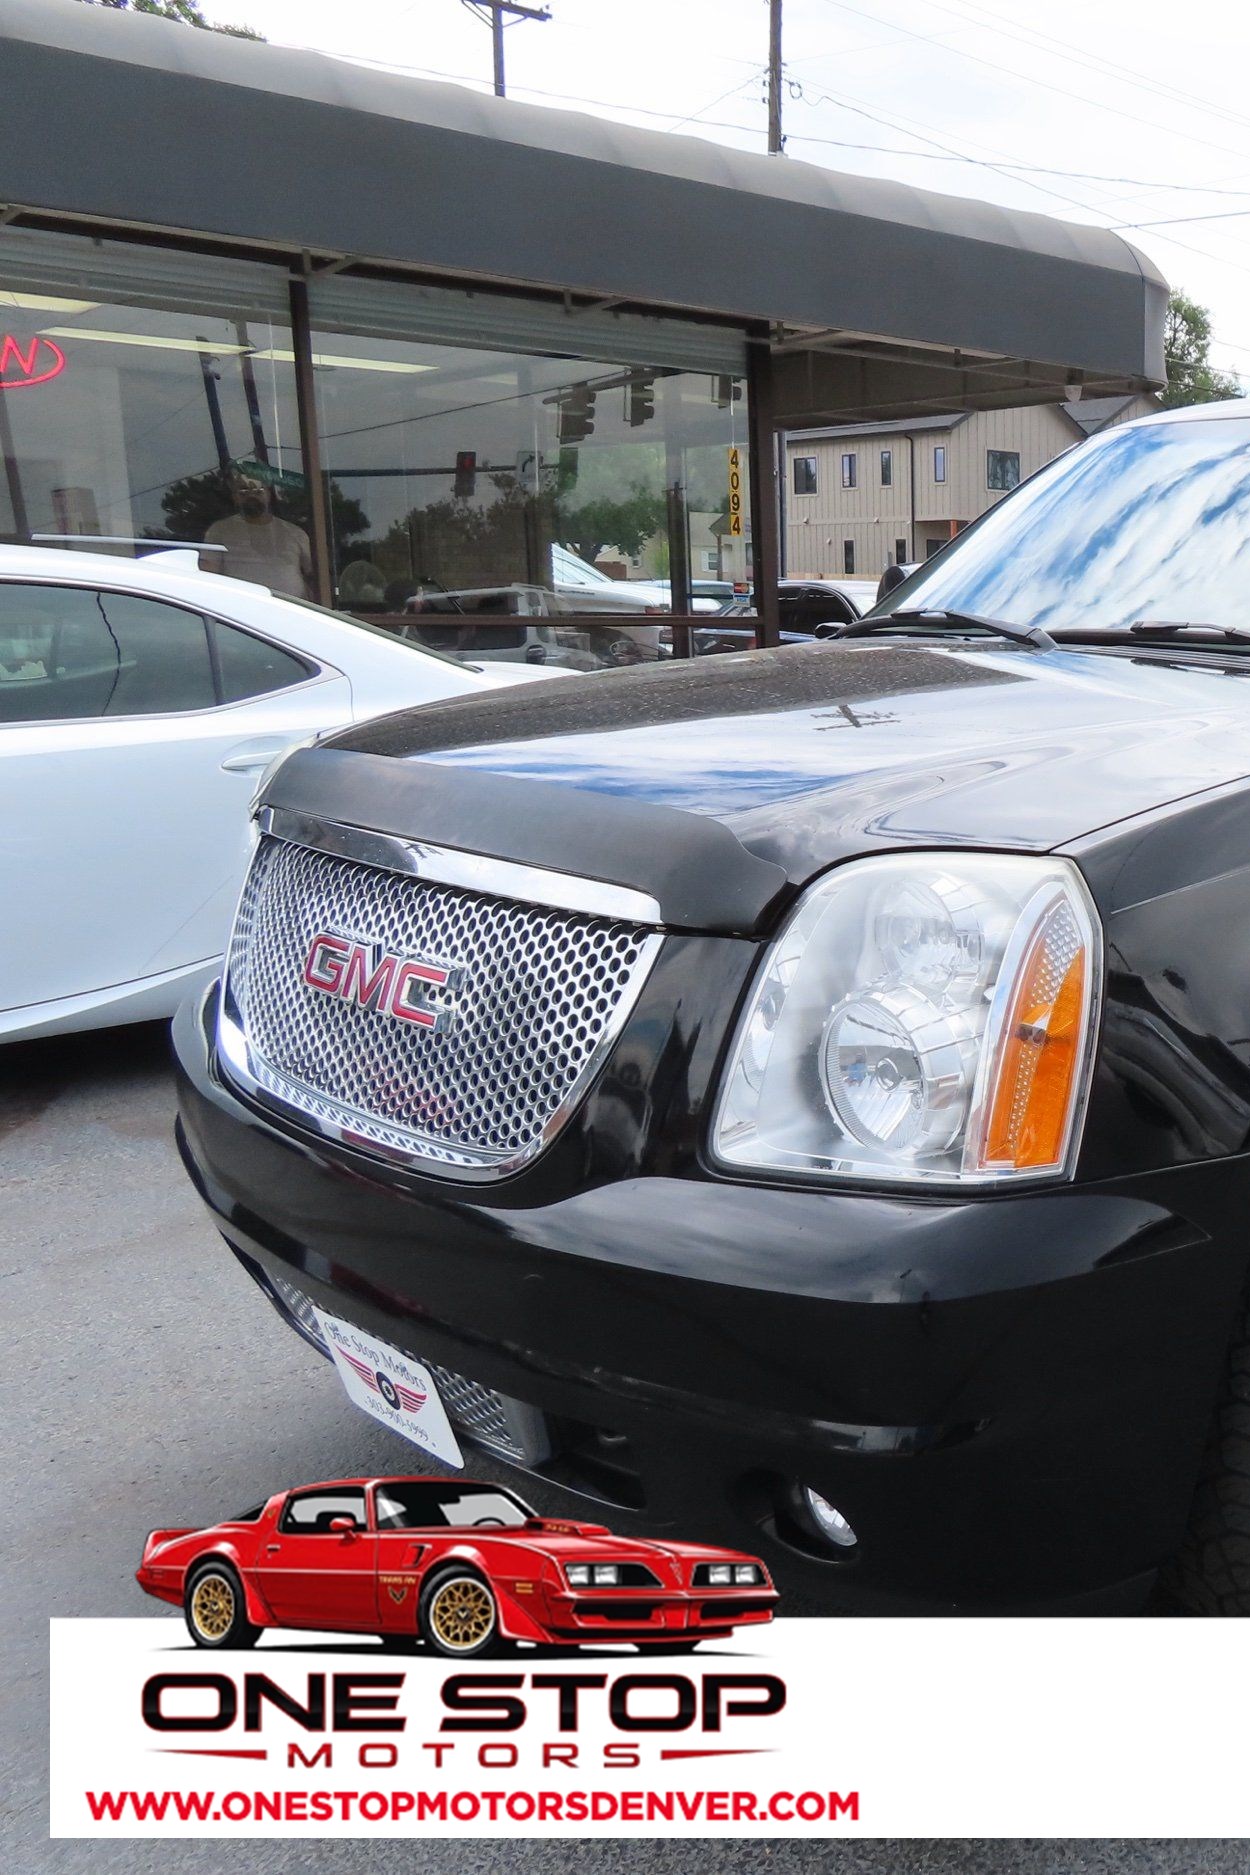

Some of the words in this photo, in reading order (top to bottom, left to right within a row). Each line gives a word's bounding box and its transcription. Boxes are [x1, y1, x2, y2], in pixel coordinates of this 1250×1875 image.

[729, 449, 742, 535] 4094
[302, 930, 460, 1034] GMC
[351, 1335, 380, 1366] Stop
[381, 1352, 427, 1391] Motors
